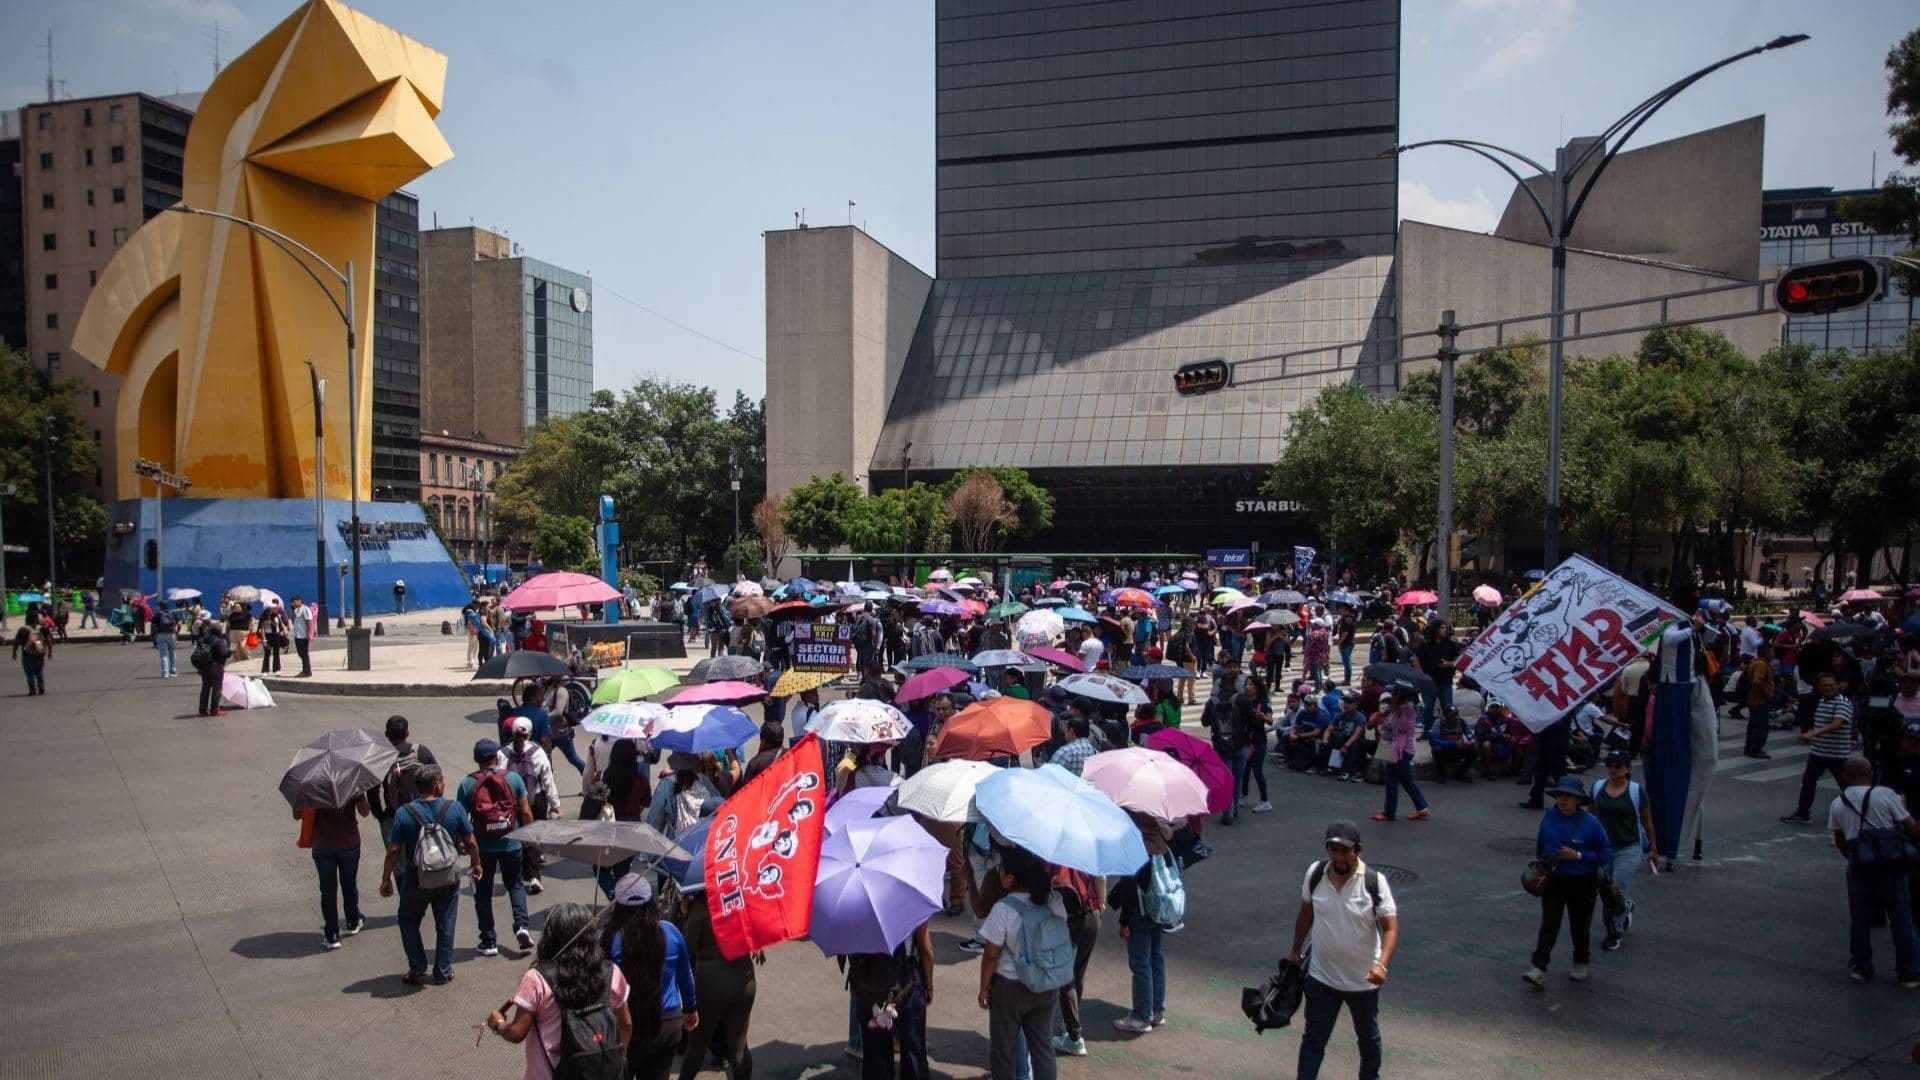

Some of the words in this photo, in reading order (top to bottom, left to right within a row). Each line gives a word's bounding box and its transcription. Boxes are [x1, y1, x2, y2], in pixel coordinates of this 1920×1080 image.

[1760, 224, 1819, 239] OTATIVA
[1830, 221, 1877, 236] ESTU
[1235, 500, 1309, 512] STARBU
[1223, 552, 1245, 562] telcel
[798, 643, 846, 654] SECTOR
[797, 653, 847, 664] TLACOLULA
[714, 814, 745, 917] CNTE
